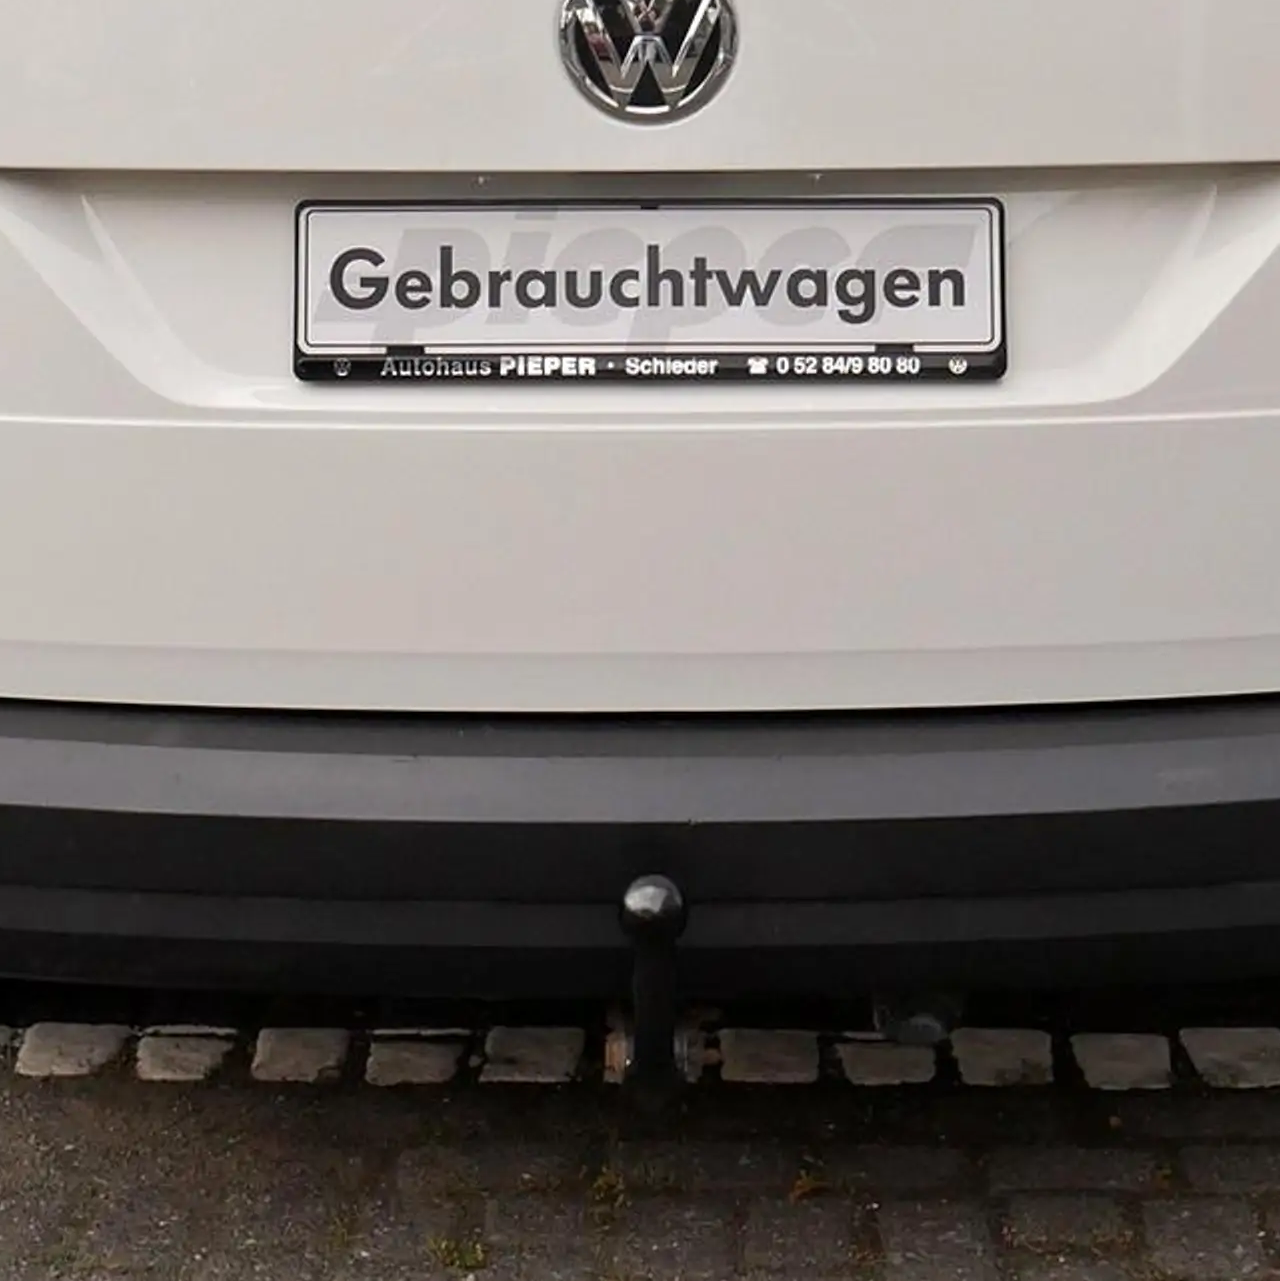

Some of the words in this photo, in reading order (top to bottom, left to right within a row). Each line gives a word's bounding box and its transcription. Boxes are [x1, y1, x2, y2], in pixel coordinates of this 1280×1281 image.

[329, 244, 965, 324] Gebrauchtwagen
[380, 356, 492, 376] Autohaus
[499, 355, 596, 376] PIEPER
[625, 356, 719, 376] Schieder
[776, 356, 790, 374] 0
[793, 356, 817, 374] 52
[822, 356, 862, 375] 84/9
[867, 356, 891, 374] 80
[896, 356, 921, 374] 80
